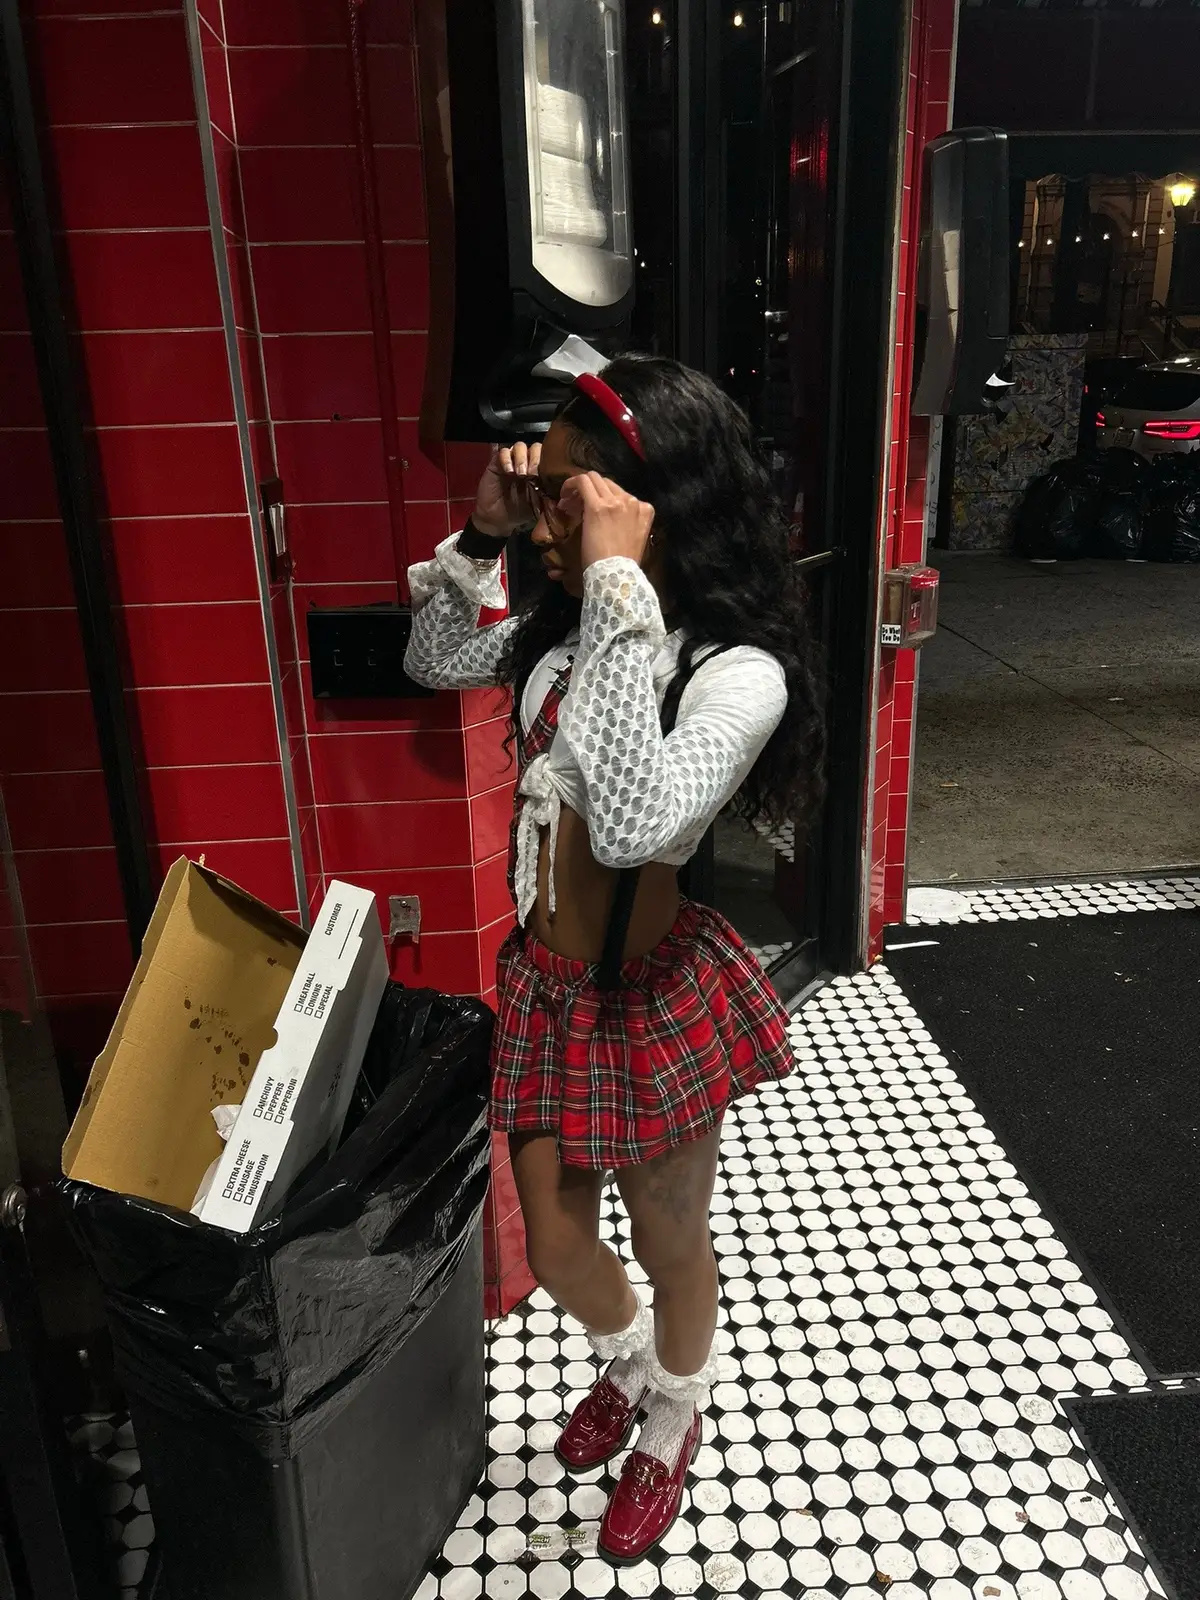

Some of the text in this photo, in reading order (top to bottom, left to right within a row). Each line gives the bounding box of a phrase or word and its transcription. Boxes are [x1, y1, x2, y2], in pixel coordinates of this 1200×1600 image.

[324, 902, 343, 937] CUSTOMER
[298, 971, 316, 1005] MEATBALL
[308, 982, 323, 1009] ONIONS
[318, 984, 333, 1011] SPECIAL
[256, 1076, 275, 1110] ANCHOVY
[267, 1081, 285, 1113] PEPPERS
[278, 1078, 298, 1116] PEPPERONI
[226, 1139, 251, 1190] EXTRA CHEESE
[237, 1159, 255, 1194] SAUSAGE
[246, 1153, 269, 1197] MUSHROOM
